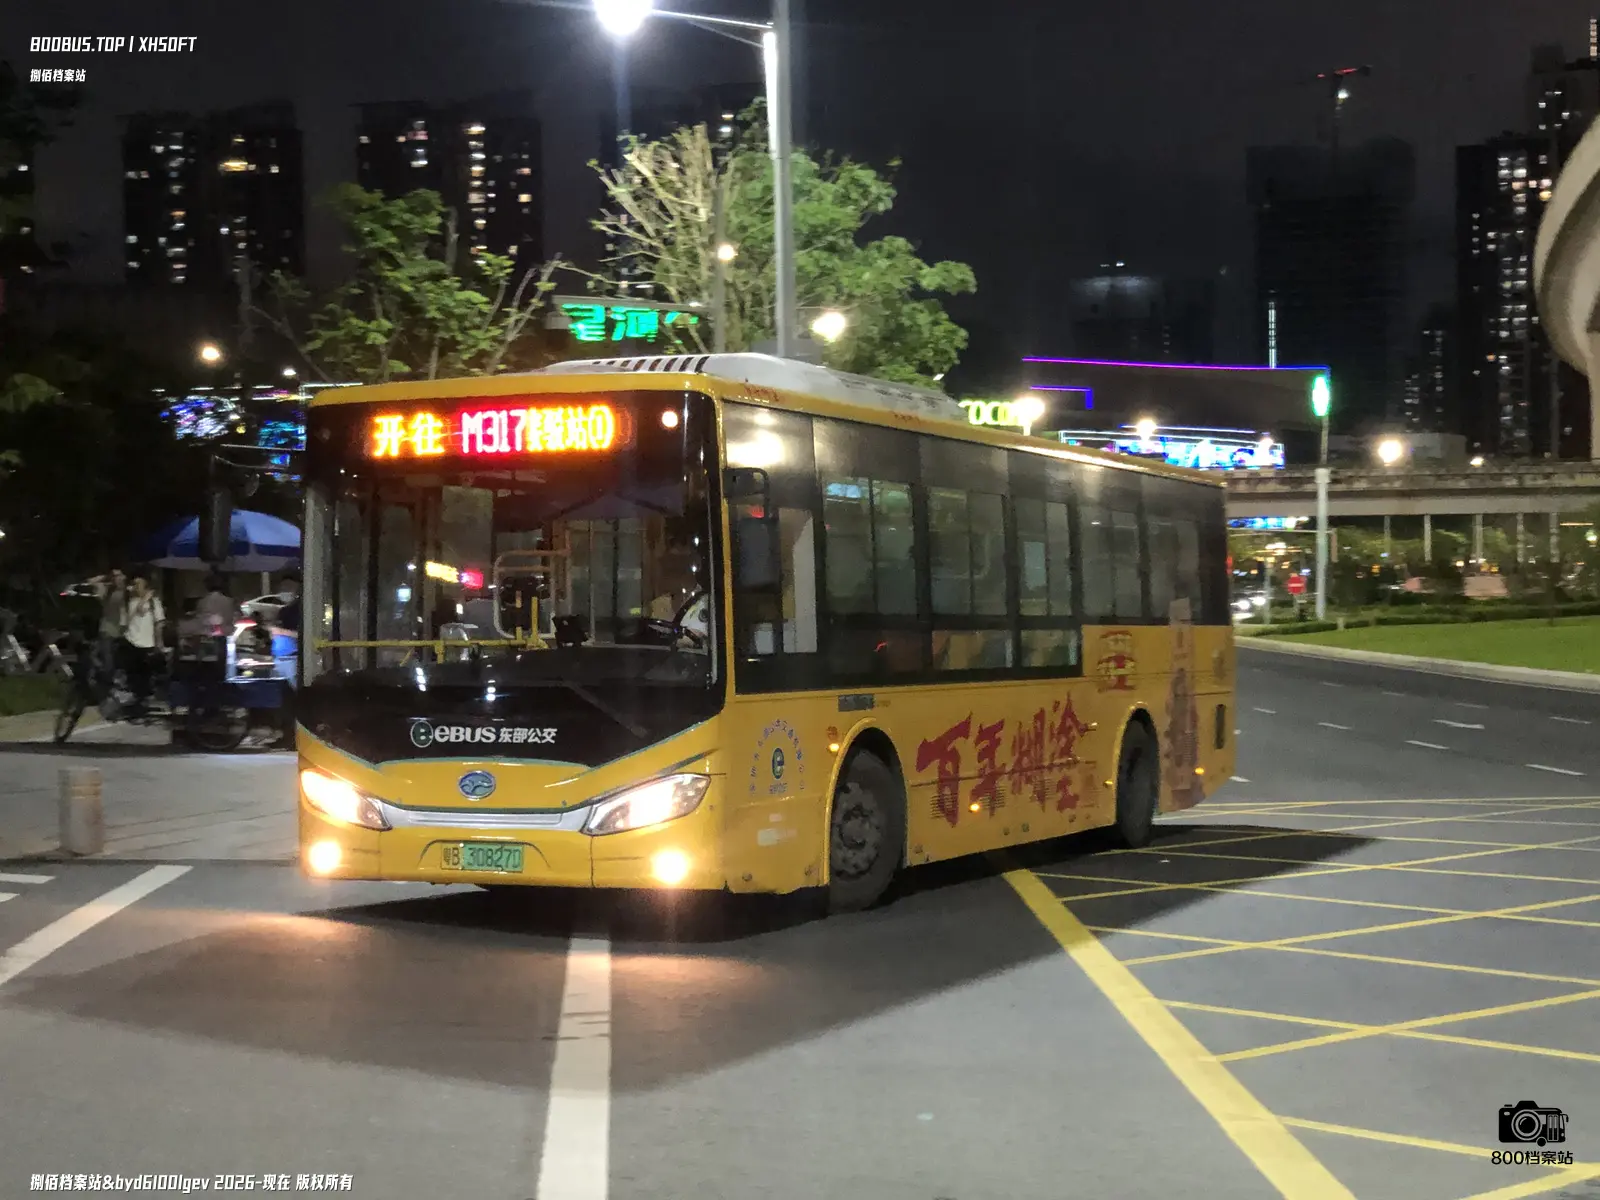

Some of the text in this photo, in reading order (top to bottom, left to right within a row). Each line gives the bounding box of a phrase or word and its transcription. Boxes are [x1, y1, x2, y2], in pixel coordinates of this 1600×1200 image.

[373, 412, 445, 458] 开往
[461, 409, 529, 454] M317
[498, 727, 557, 744] 东部公交
